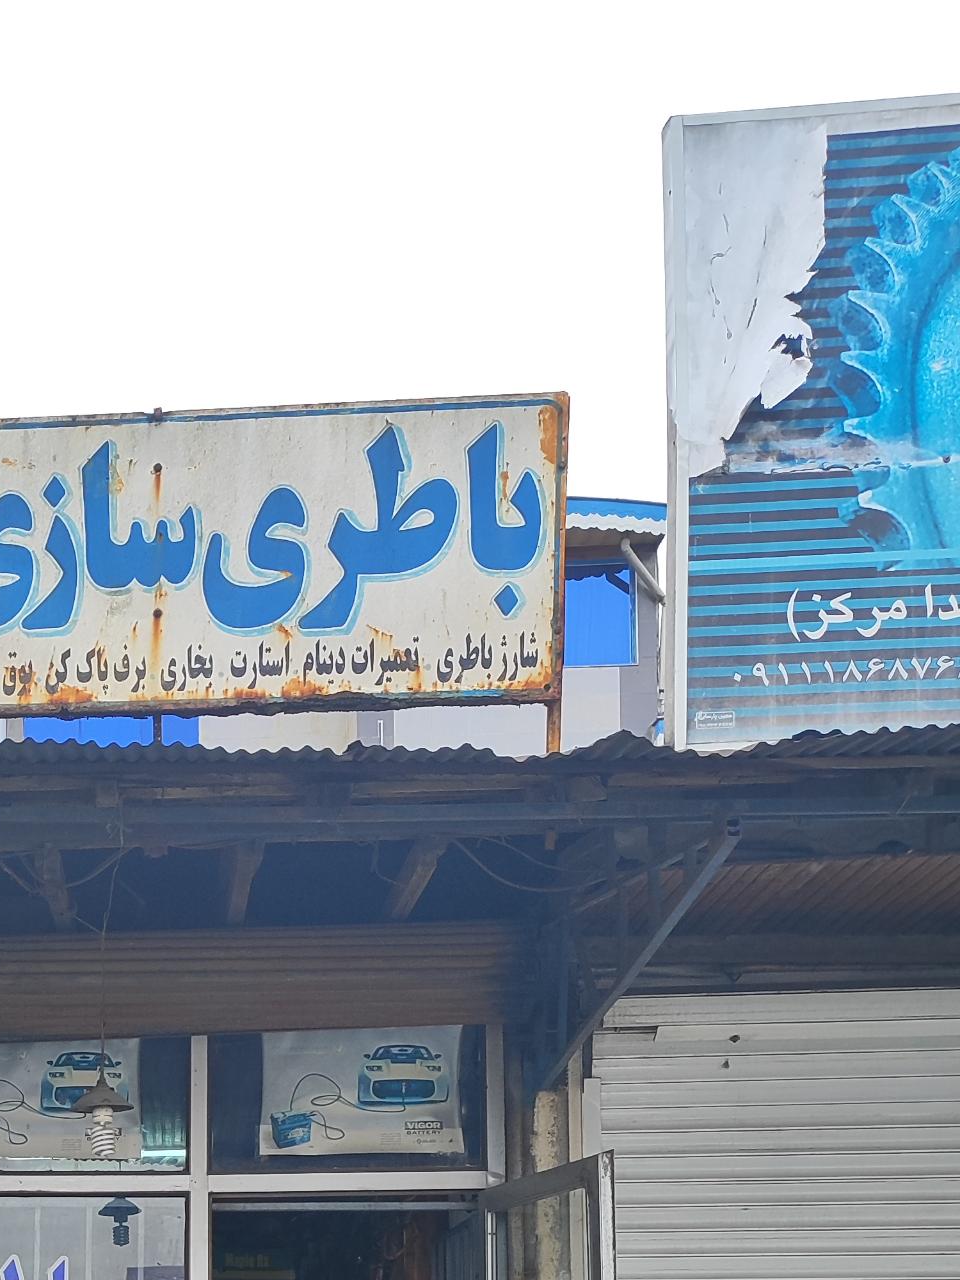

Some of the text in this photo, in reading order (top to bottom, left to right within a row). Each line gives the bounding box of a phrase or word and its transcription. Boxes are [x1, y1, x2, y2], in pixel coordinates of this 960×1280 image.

[202, 420, 546, 636] باطری
[924, 583, 960, 621] دا
[2, 652, 33, 697] بوق
[45, 646, 71, 695] کن
[76, 647, 109, 695] پاک
[113, 643, 147, 693] برف
[160, 643, 214, 692] بخاری
[230, 640, 291, 690] استارت
[303, 639, 346, 685] دینام
[351, 636, 420, 686] تعمیرات
[436, 632, 494, 684] باطری
[497, 631, 539, 682] شارژ
[733, 655, 960, 687] ۰۹۱۱۱۸۶۸۷۶
[406, 1121, 441, 1130] VIGOR
